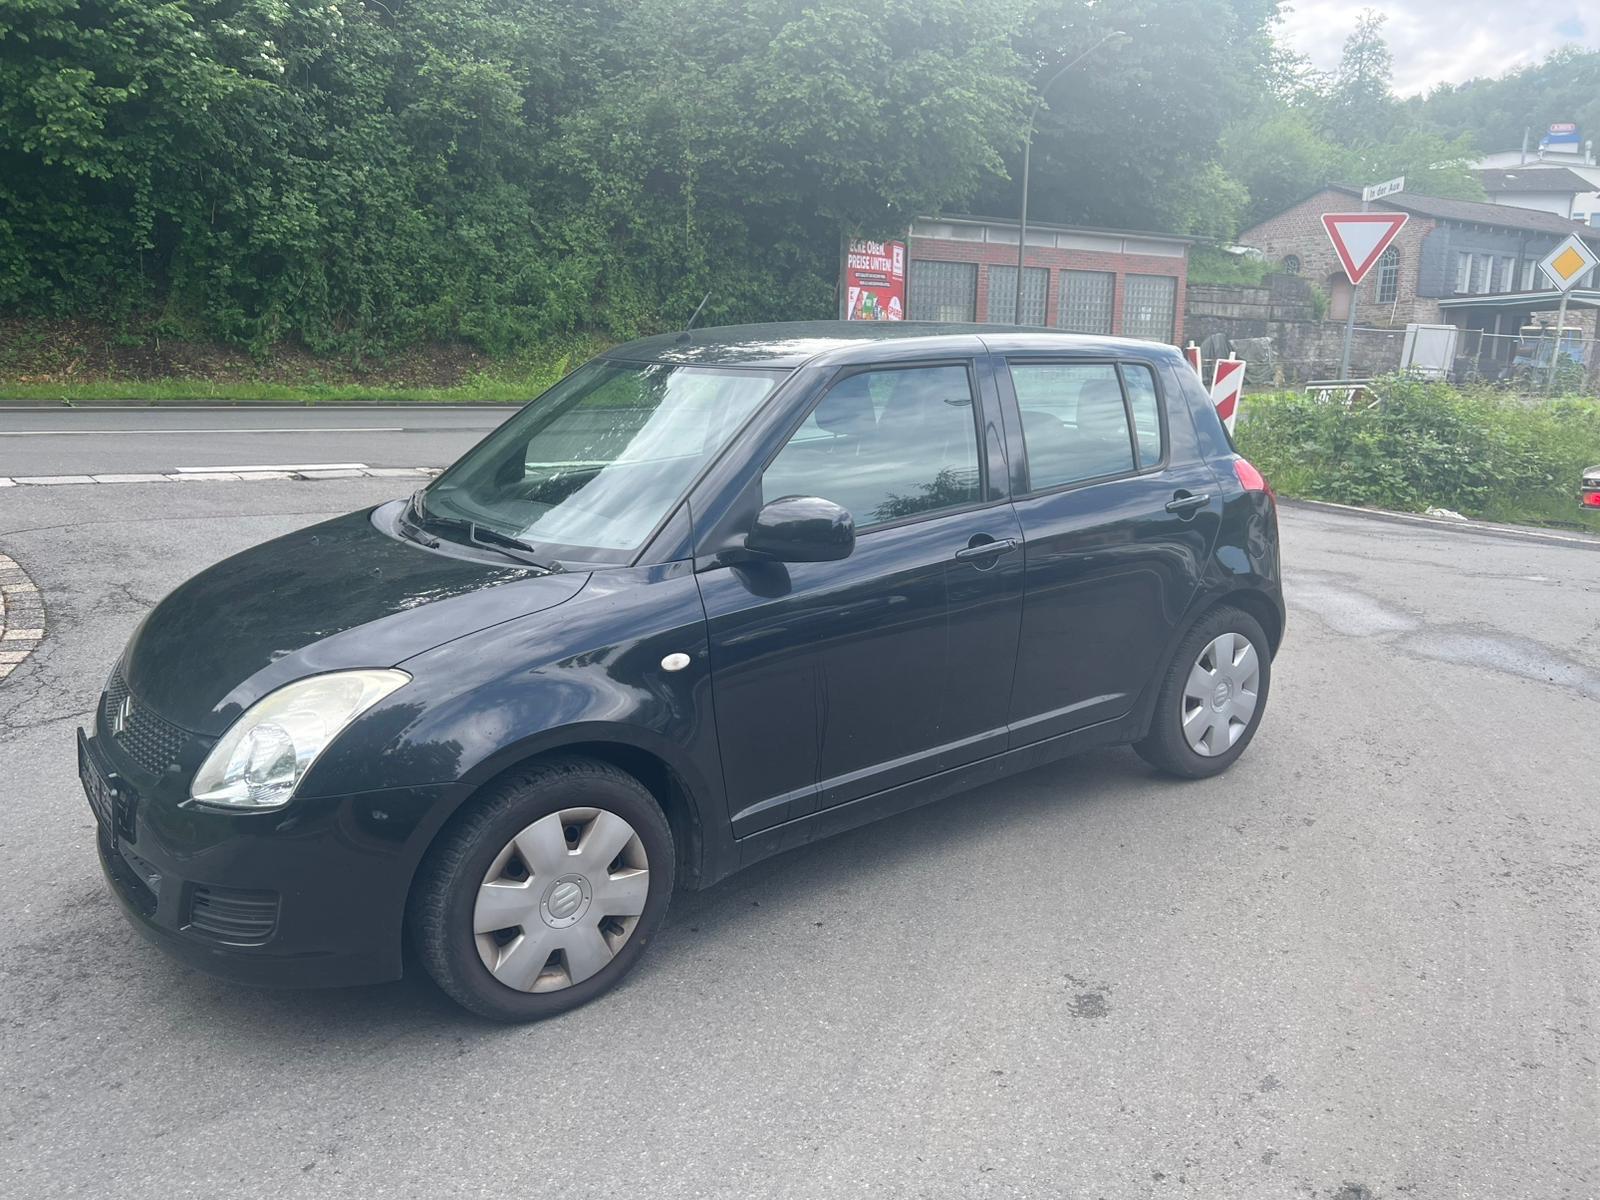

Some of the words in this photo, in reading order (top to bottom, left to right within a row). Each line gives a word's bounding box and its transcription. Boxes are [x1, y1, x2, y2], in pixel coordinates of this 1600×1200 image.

[1377, 185, 1387, 196] der
[1388, 182, 1401, 193] Aue
[848, 254, 870, 270] PREISE
